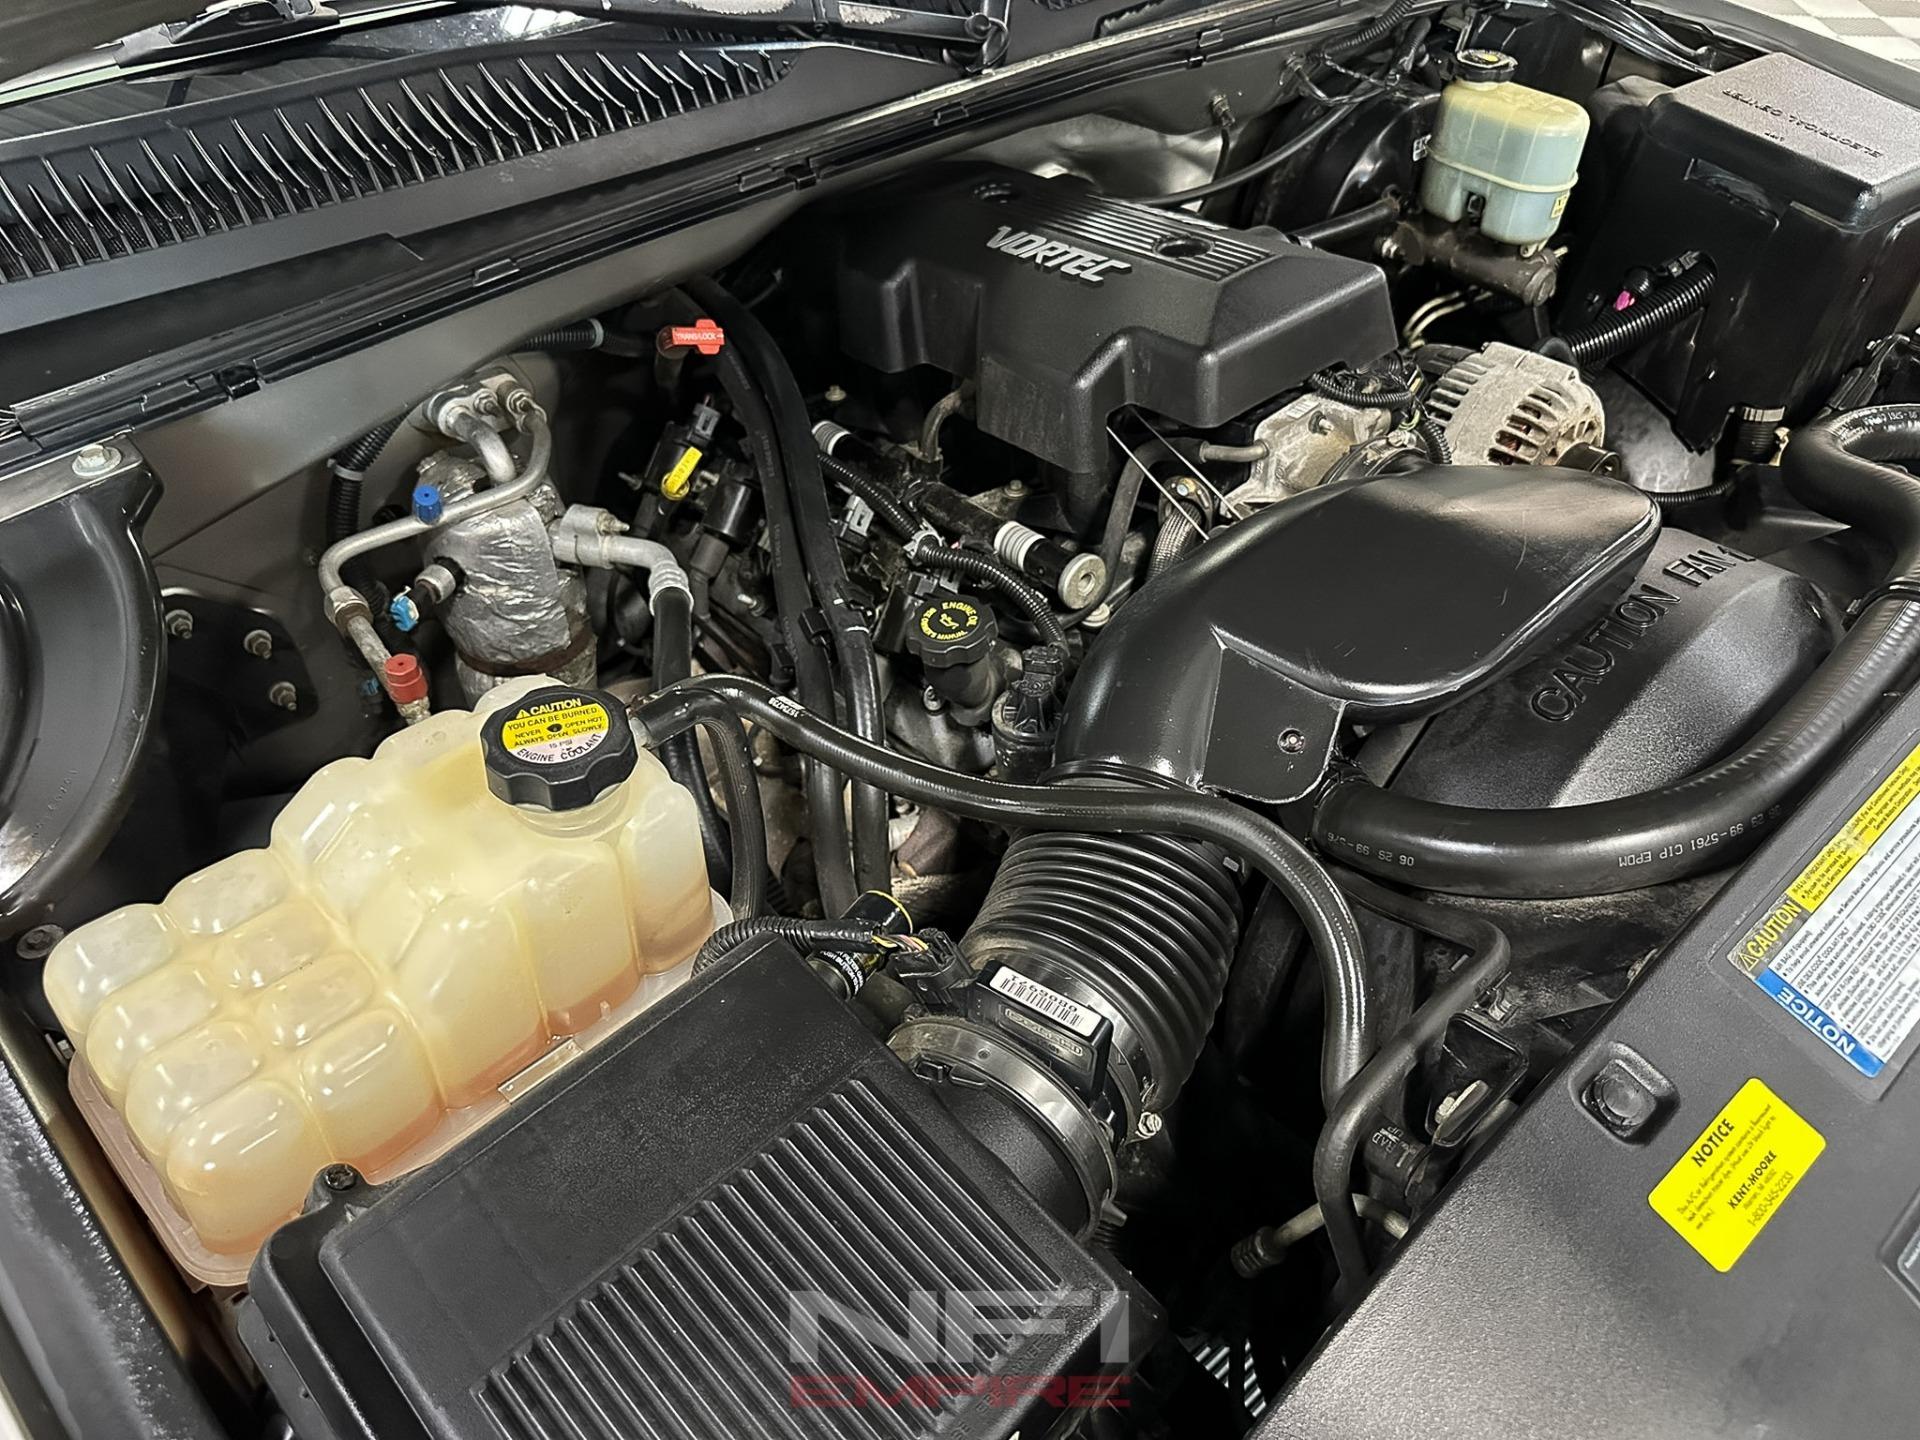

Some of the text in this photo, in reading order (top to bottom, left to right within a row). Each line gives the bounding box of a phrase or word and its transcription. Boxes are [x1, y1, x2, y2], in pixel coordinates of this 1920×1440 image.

[986, 225, 1131, 282] VORTEC
[1530, 550, 1737, 722] CAUTION FAN
[530, 698, 581, 716] CAUTION
[508, 722, 526, 731] YOU
[528, 718, 546, 726] CAN
[515, 729, 541, 738] NEVER
[565, 720, 586, 728] OPEN
[514, 736, 545, 747] ALWAYS
[517, 734, 602, 762] ENGINE COOLANT
[1617, 850, 1652, 867] EPDM
[1657, 842, 1683, 859] CIP
[1746, 898, 1800, 958] CAUTION
[1777, 987, 1855, 1054] NOTICE
[1689, 1116, 1735, 1168] NOTICE
[1728, 1150, 1775, 1208] KENT-MOORE
